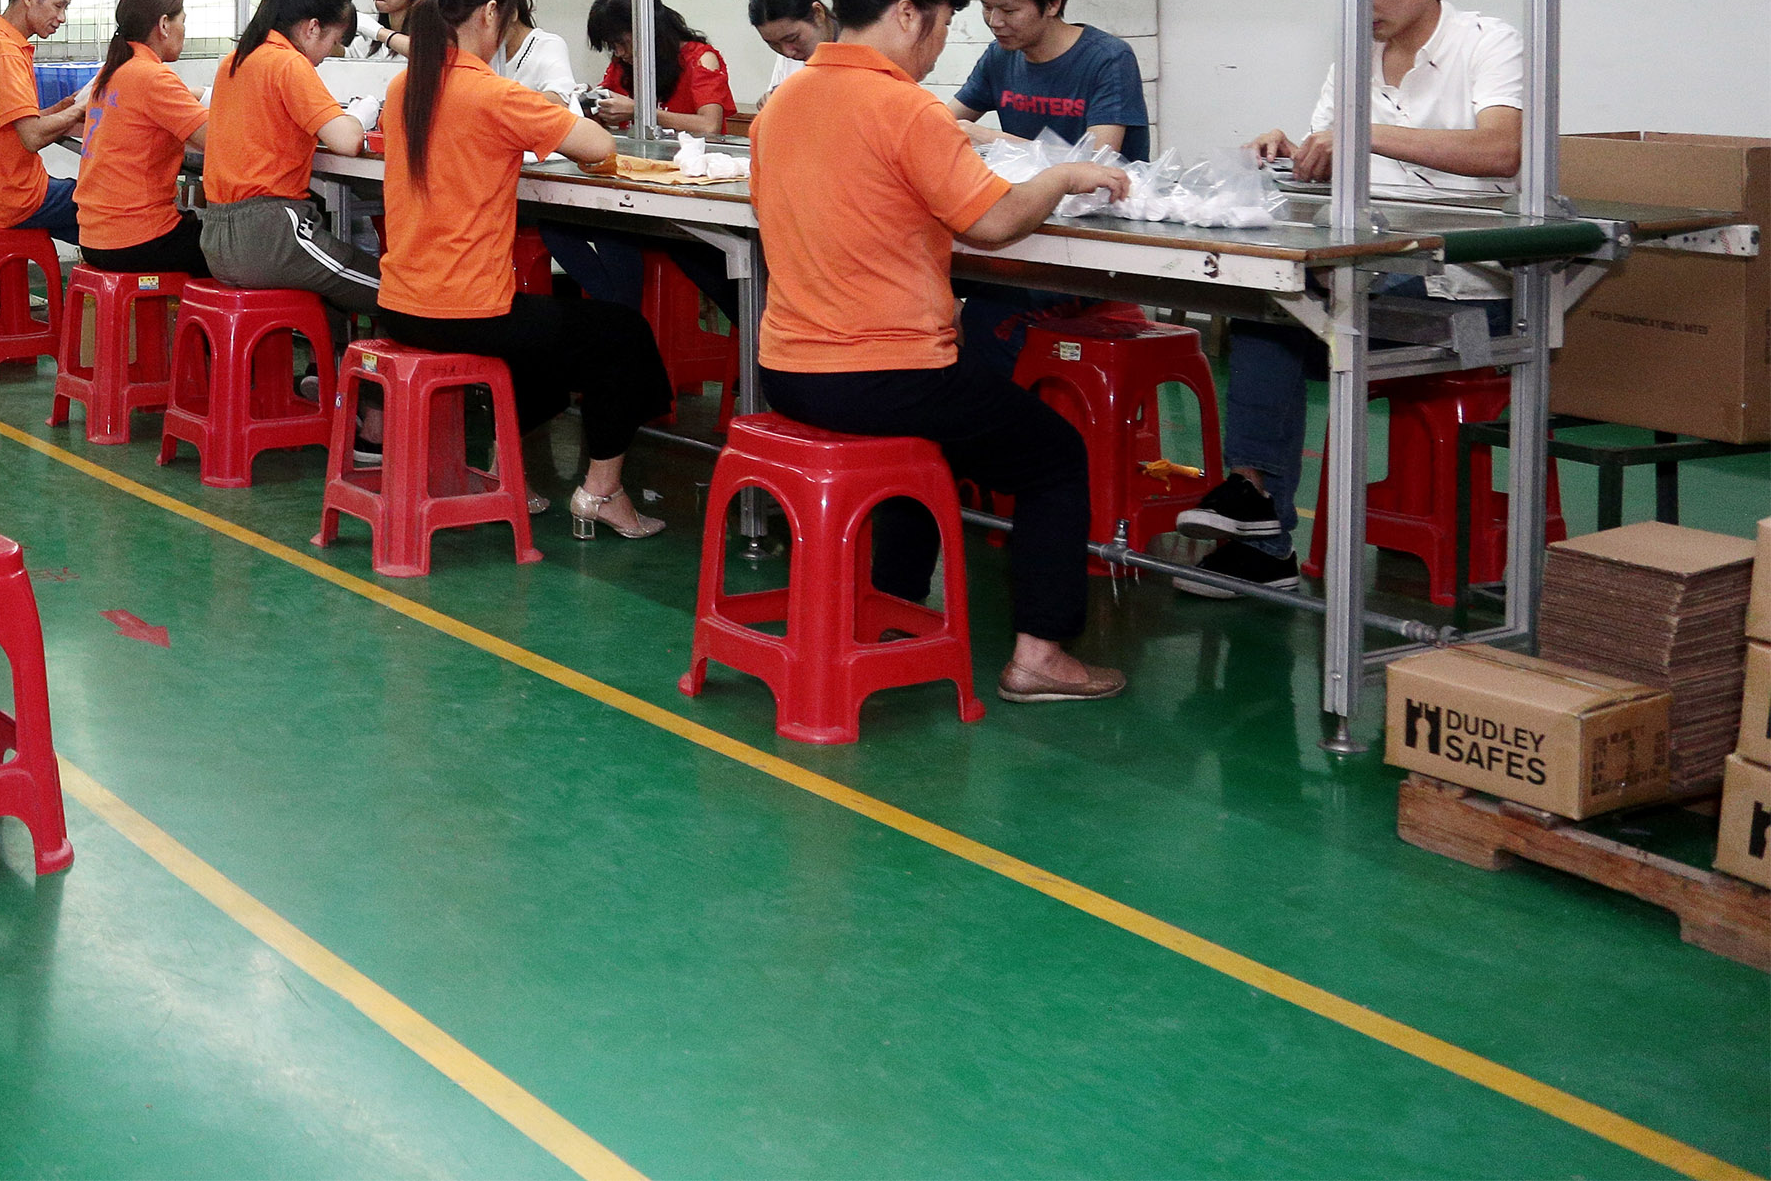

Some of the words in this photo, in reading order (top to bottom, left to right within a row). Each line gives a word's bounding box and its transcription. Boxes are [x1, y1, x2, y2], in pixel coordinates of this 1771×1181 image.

[1000, 90, 1086, 117] FGHTERS
[1446, 709, 1545, 752] DUDLEY
[1445, 734, 1546, 785] SAFES
